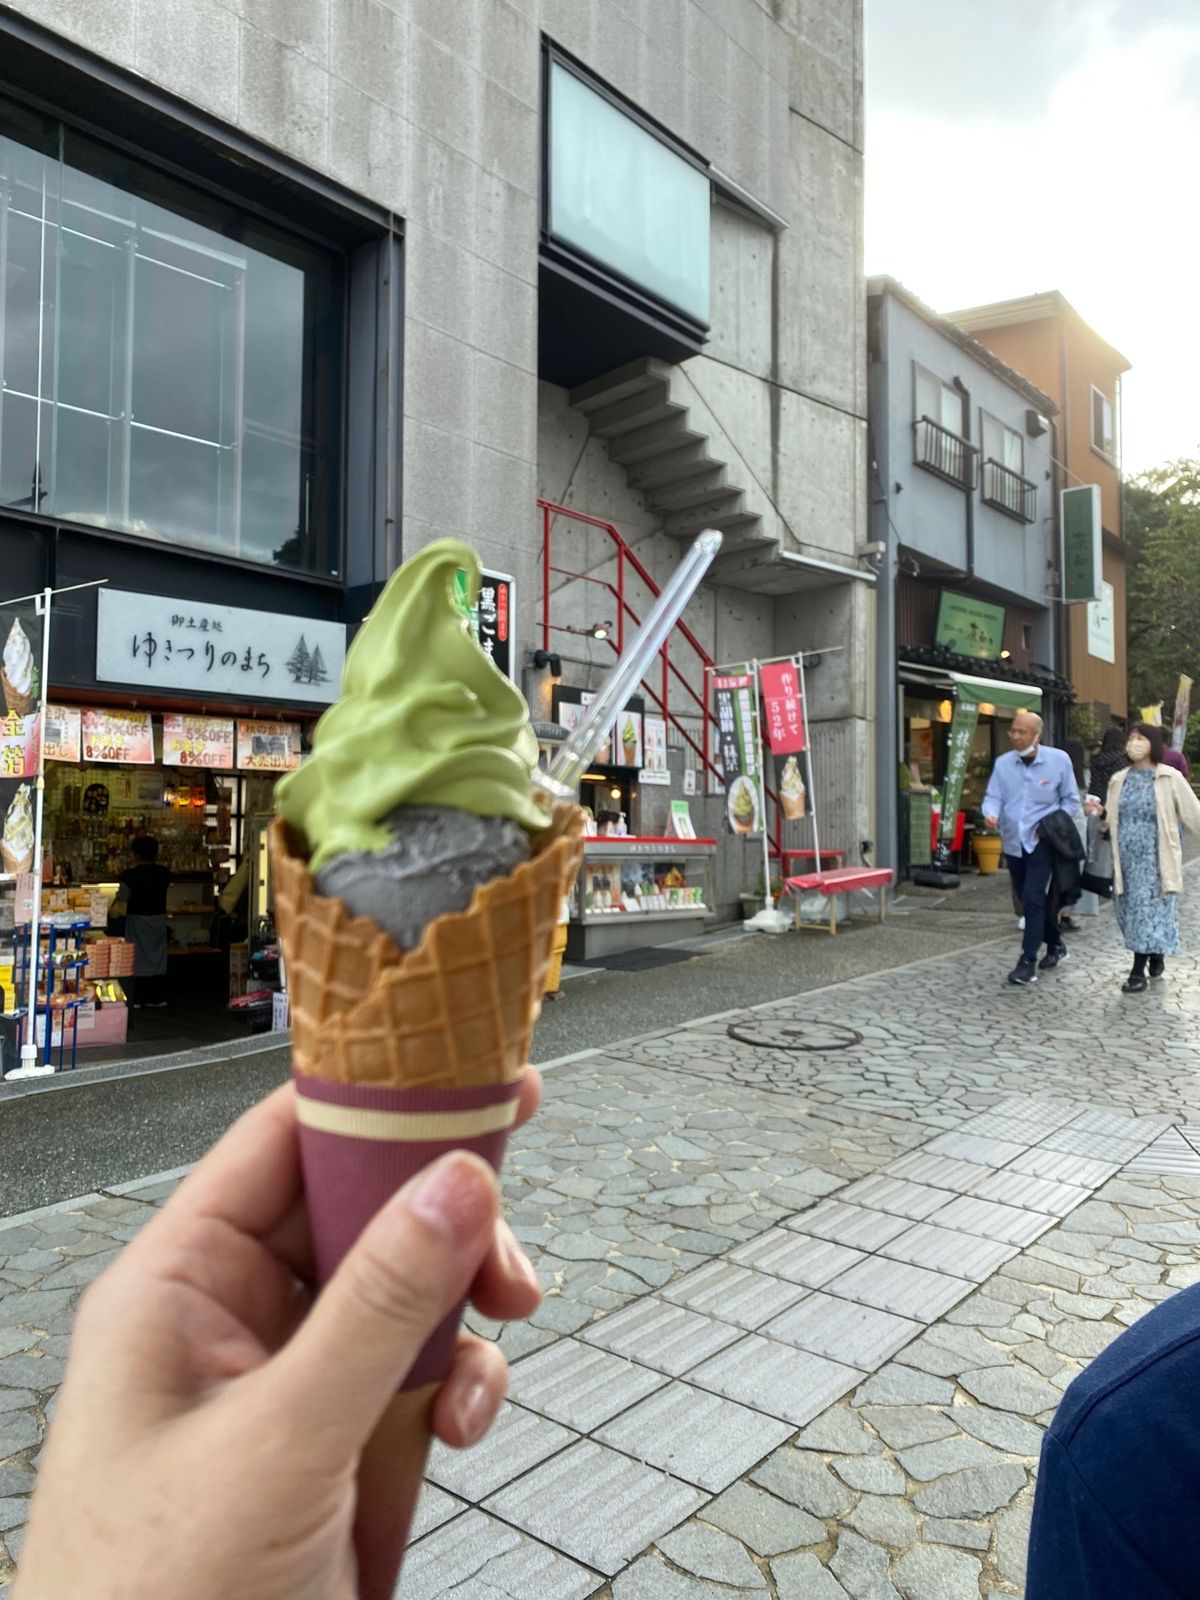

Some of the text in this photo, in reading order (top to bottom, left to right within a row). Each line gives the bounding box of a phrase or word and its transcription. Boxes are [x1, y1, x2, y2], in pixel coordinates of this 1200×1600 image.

[171, 613, 224, 633] 御土産処
[132, 631, 270, 678] ゆきつりのまち
[781, 672, 799, 736] 作り続けて
[105, 723, 149, 738] 5%OFF
[186, 728, 232, 744] 5%OFF
[1, 708, 26, 777] 金箔
[86, 745, 131, 760] 8%OFF
[180, 751, 227, 766] 8%OFF
[245, 753, 293, 769] 大売出し
